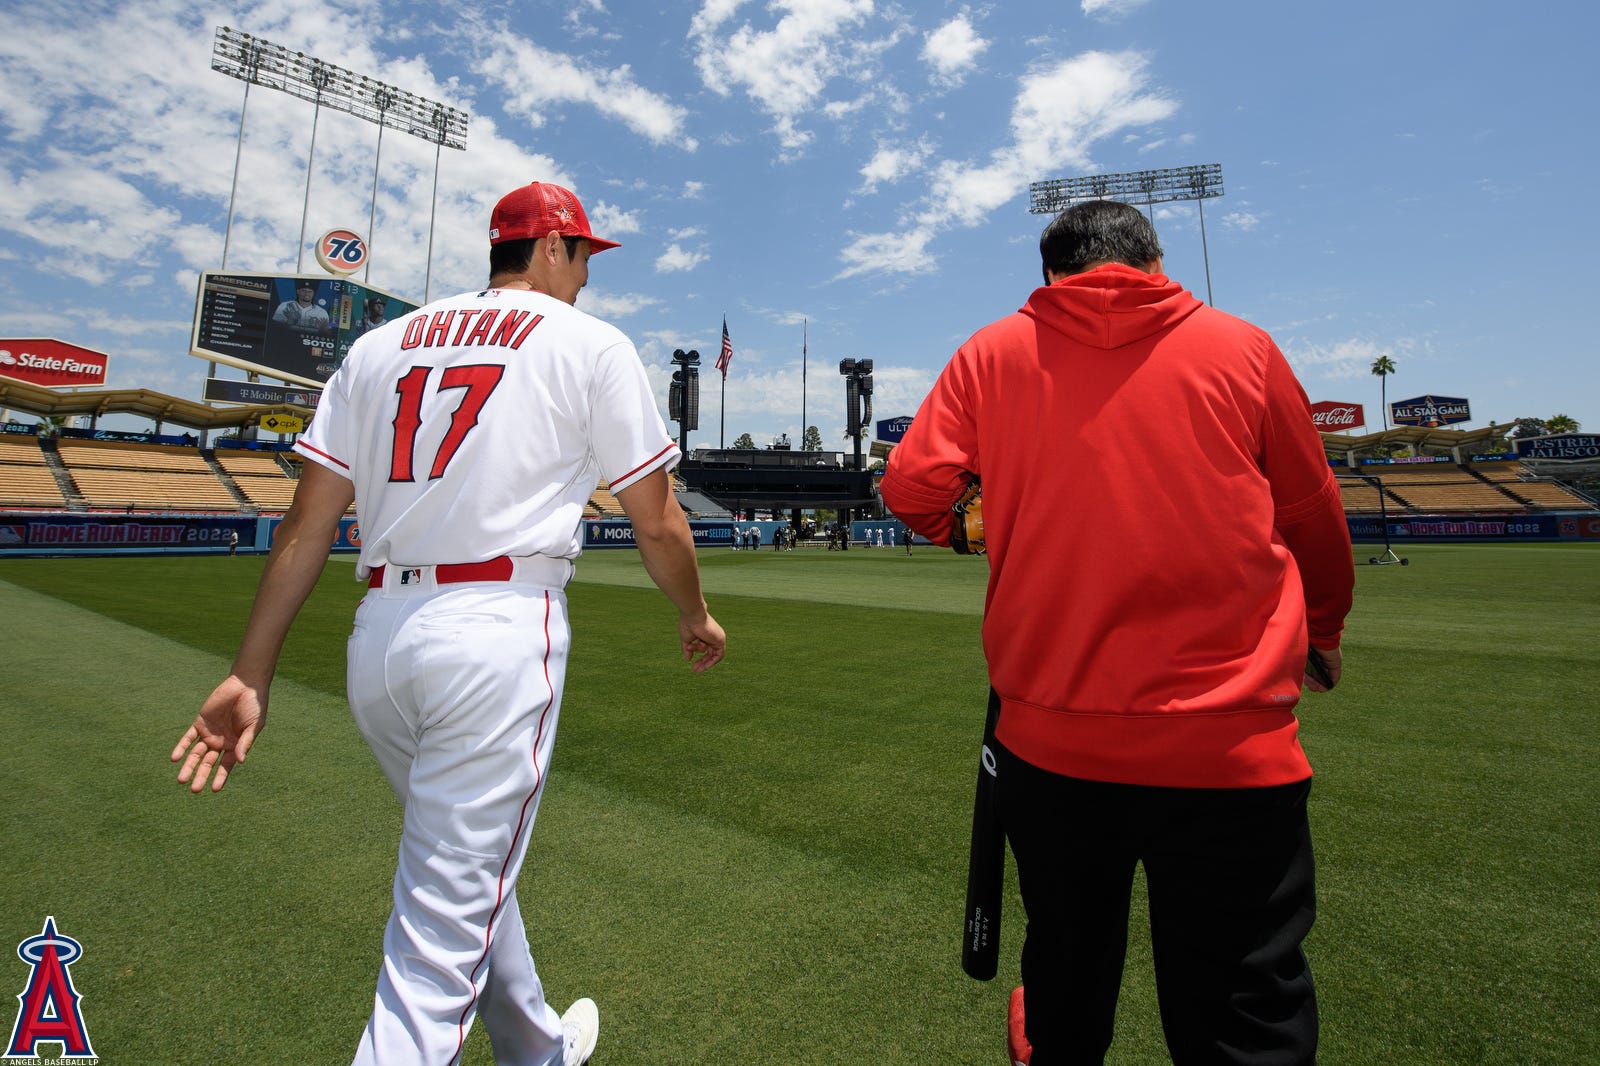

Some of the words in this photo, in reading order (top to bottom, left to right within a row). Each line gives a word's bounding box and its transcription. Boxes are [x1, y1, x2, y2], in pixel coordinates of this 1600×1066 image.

[326, 236, 364, 264] 76
[212, 275, 268, 289] AMERICAN
[401, 309, 545, 350] OHTANI
[302, 339, 335, 349] SOTO
[250, 390, 282, 401] Mobile
[1395, 408, 1412, 418] ALL
[1414, 407, 1438, 417] STAR
[1438, 405, 1468, 415] GAME
[280, 420, 297, 429] cpk
[388, 364, 506, 483] 17
[1527, 446, 1599, 458] JALISCO
[709, 528, 732, 538] SELTZER
[1352, 525, 1383, 535] Mobile
[1507, 523, 1540, 533] 2022
[187, 528, 232, 541] 2022
[351, 528, 360, 541] 7
